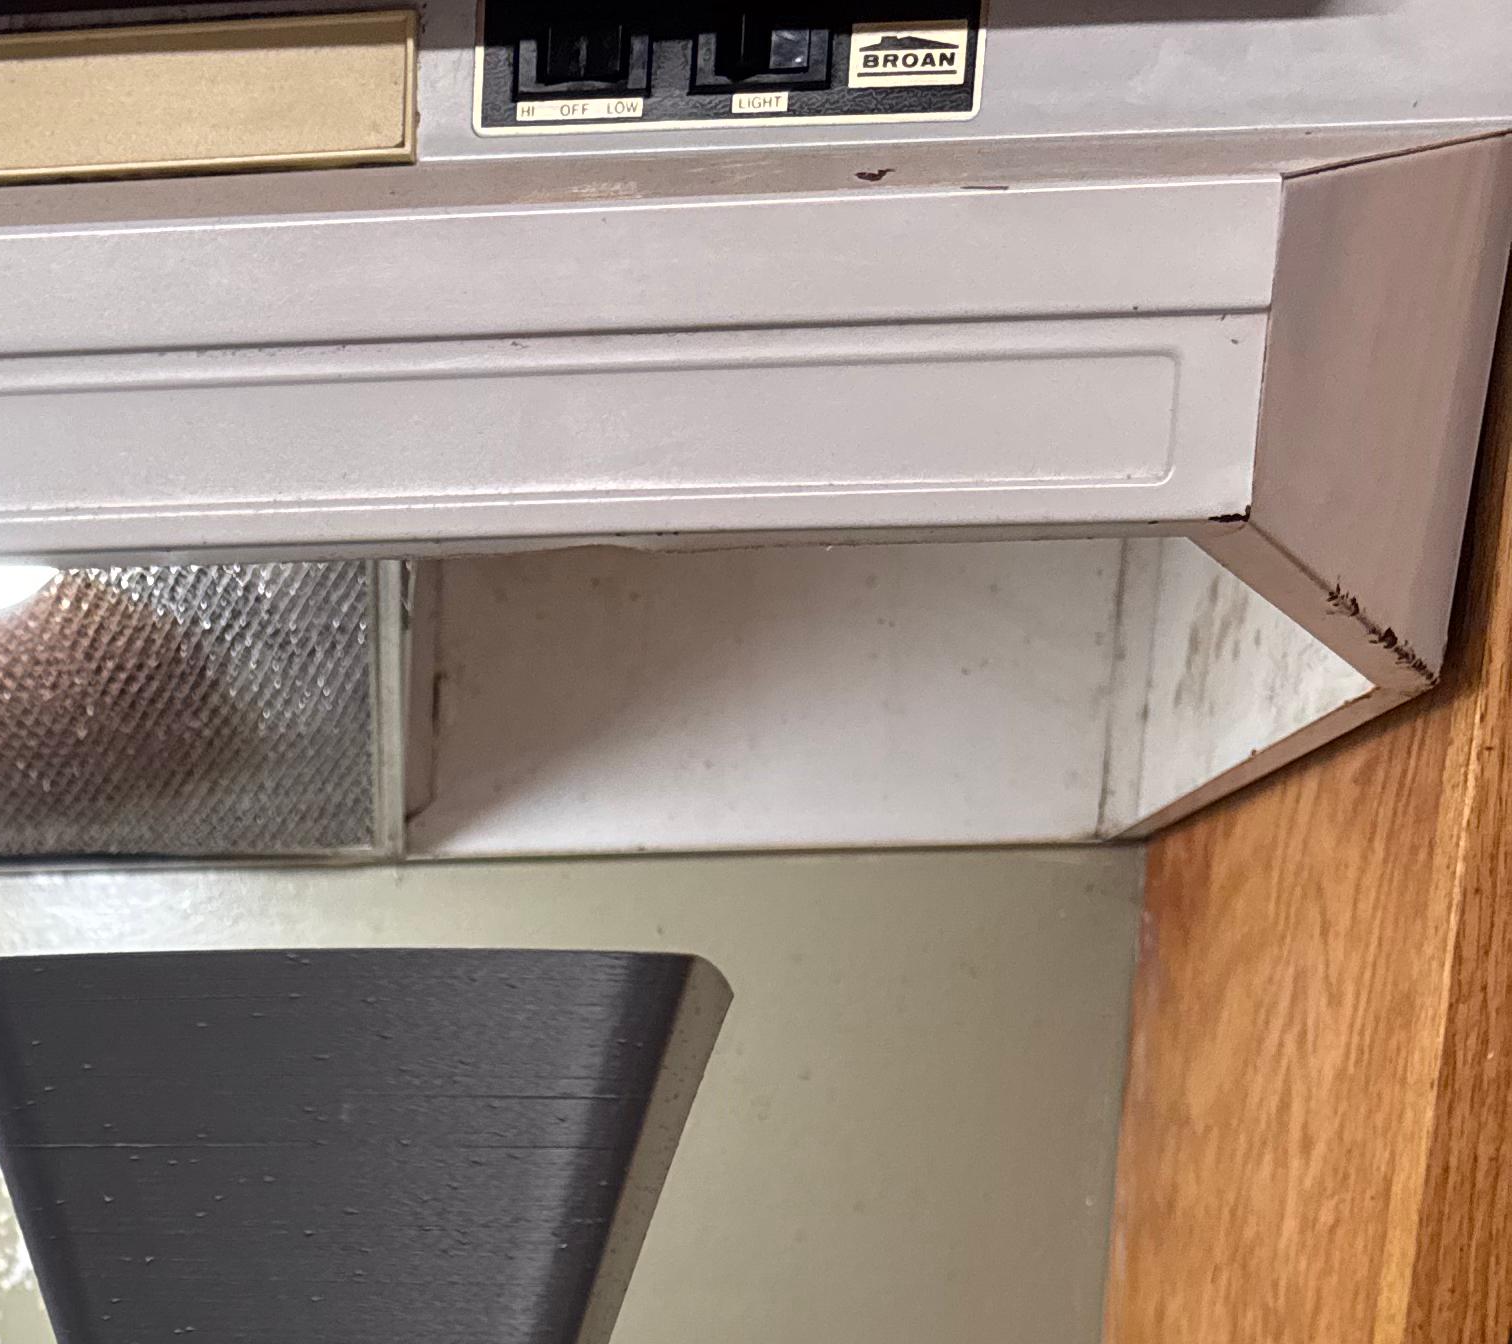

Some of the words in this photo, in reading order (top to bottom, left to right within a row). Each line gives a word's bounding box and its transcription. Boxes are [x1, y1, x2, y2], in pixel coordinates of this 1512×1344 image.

[862, 51, 956, 69] BROAN
[521, 104, 535, 118] HI
[559, 103, 589, 117] OFF
[606, 101, 639, 115] LOW
[737, 95, 782, 110] LIGHT
